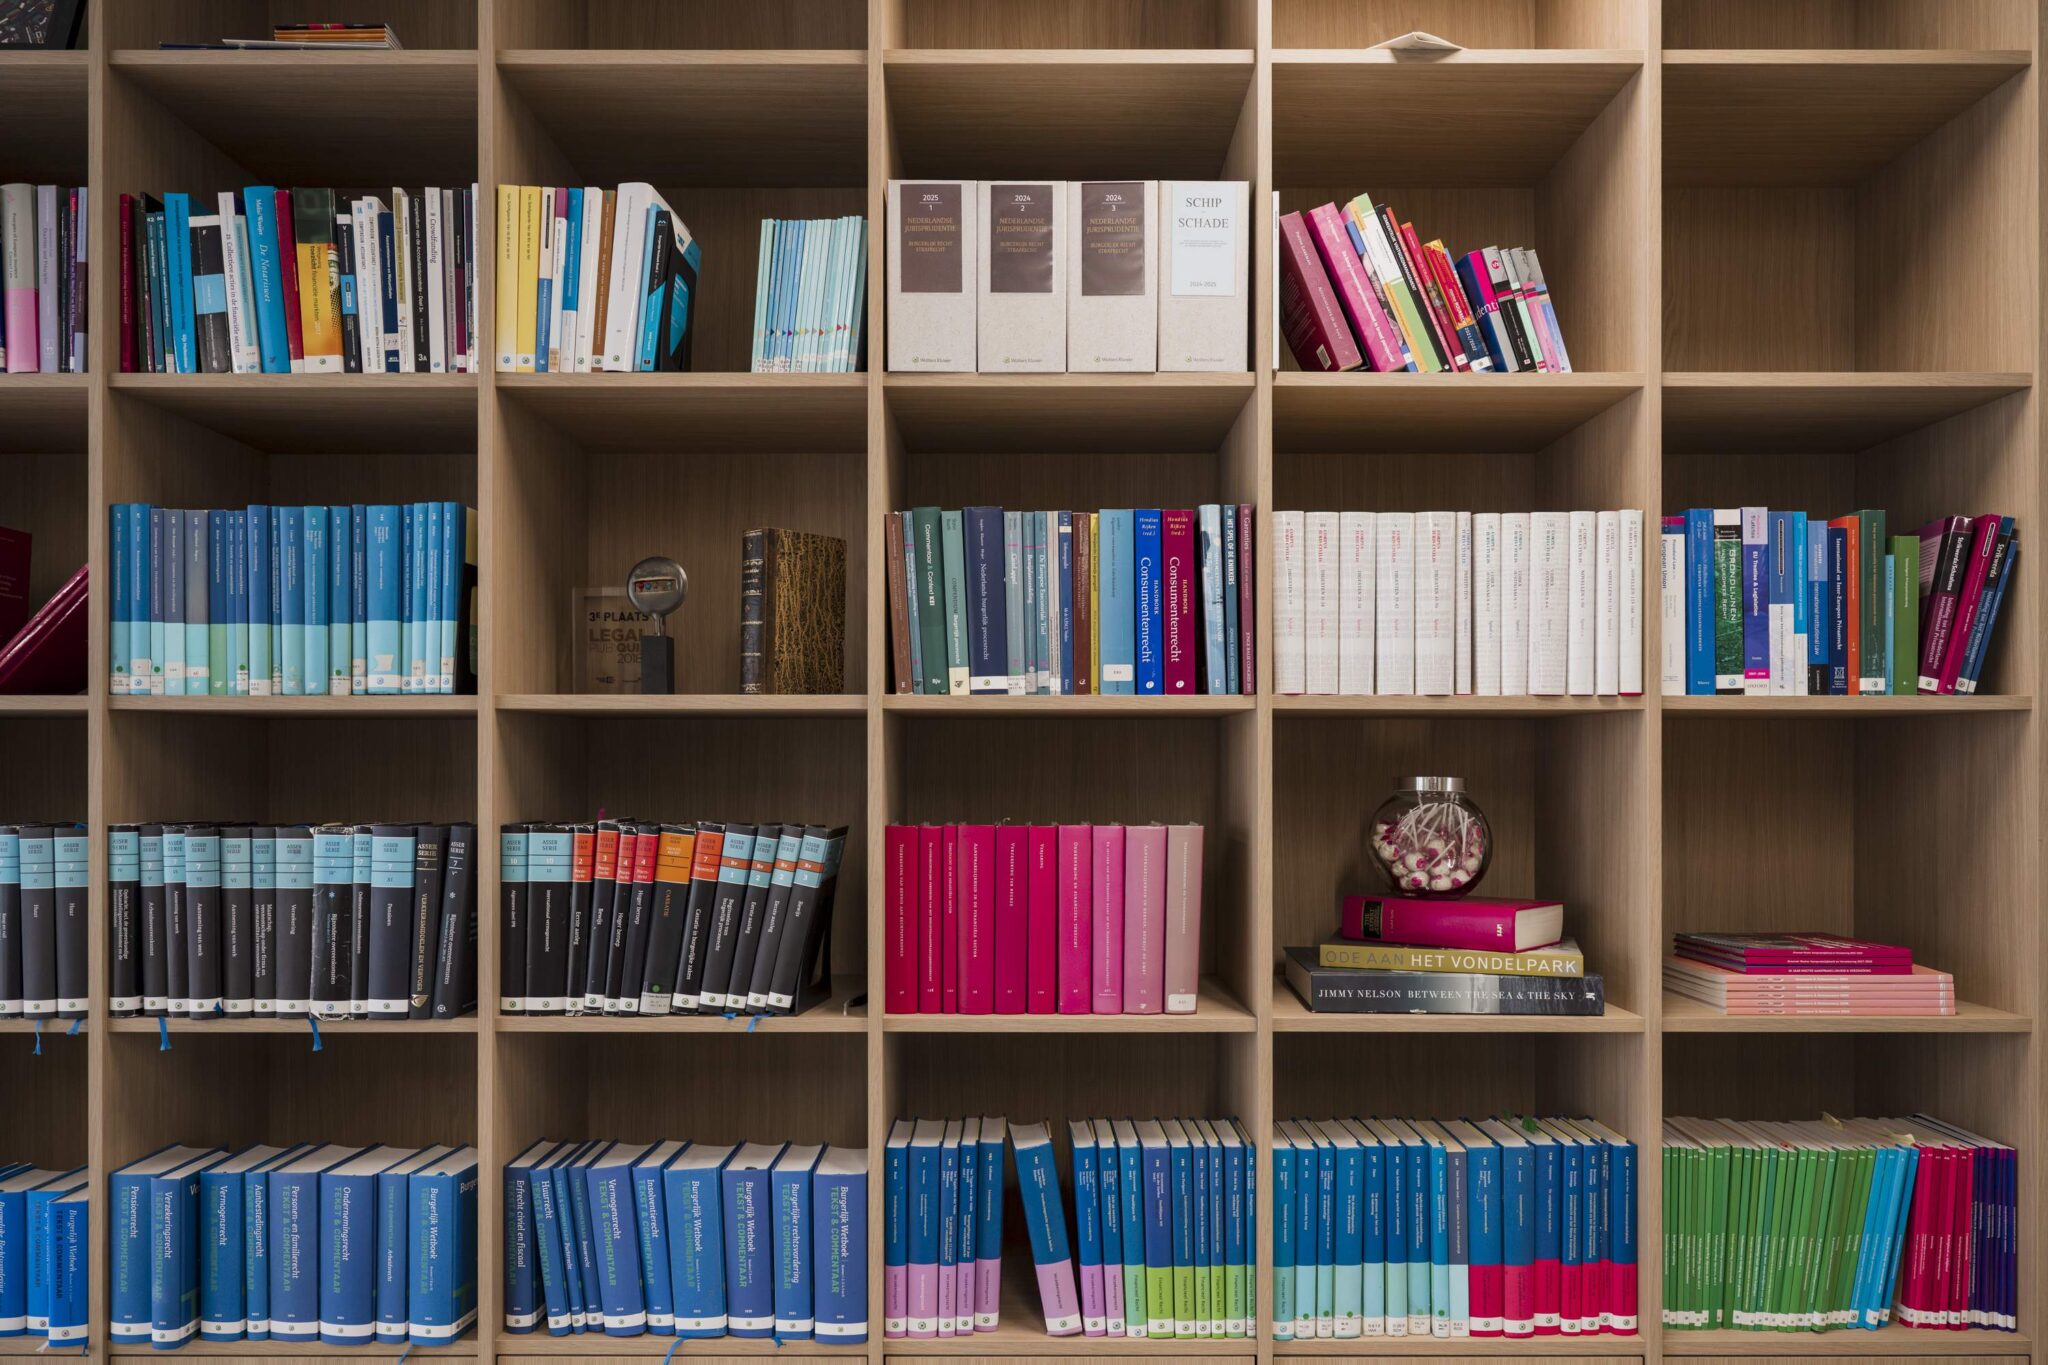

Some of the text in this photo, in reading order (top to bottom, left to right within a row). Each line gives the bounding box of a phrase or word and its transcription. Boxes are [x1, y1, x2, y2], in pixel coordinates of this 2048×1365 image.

[1185, 197, 1222, 208] SCHIP
[1178, 217, 1229, 229] SCHADE
[259, 244, 271, 303] De Notariswet
[924, 524, 933, 564] Commentaar
[1947, 537, 1964, 591] Strikwerda/Schaafsma
[1989, 543, 2005, 578] Strikwerda
[604, 612, 649, 622] PLAATS
[1140, 557, 1151, 663] Consumentenrecht
[1169, 557, 1180, 663] Consumentenrecht
[1929, 596, 1948, 663] Internationaal Privaatrecht
[616, 643, 640, 652] QUI
[693, 908, 702, 930] Cassatie
[418, 955, 424, 964] EN
[688, 937, 698, 963] burgerlijke
[1326, 951, 1577, 973] ODE AAN HET VONDELPARK
[1318, 989, 1575, 1000] JIMMY NELSON BETWEEN THE SEA & THE SKY
[130, 1186, 138, 1238] Pensioenrecht
[541, 1180, 553, 1219] Huurrecht
[599, 1180, 608, 1209] TEKST
[607, 1179, 621, 1239] Vermogensrecht
[647, 1179, 659, 1238] Insolventierecht
[736, 1181, 744, 1211] TEKST
[839, 1186, 848, 1223] Burgerlijk
[163, 1192, 172, 1258] Verzekeringsrecht
[218, 1185, 228, 1246] Vermogensrecht
[254, 1184, 263, 1257] Aanbestedingsrecht
[290, 1185, 299, 1278] Personen- en familierecht
[340, 1186, 351, 1261] Ondernemingsrecht
[745, 1181, 755, 1252] Burgerlijk Wetboek
[790, 1183, 800, 1283] Burgerlijke rechtsvordering
[68, 1210, 77, 1272] Burgerlijk Wetboek
[517, 1232, 524, 1241] en
[517, 1243, 526, 1267] fiscaal
[564, 1242, 572, 1270] Pachtrecht
[582, 1241, 590, 1268] Bouwrecht
[603, 1223, 616, 1286] COMMENTAAR
[737, 1223, 747, 1287] COMMENTAAR
